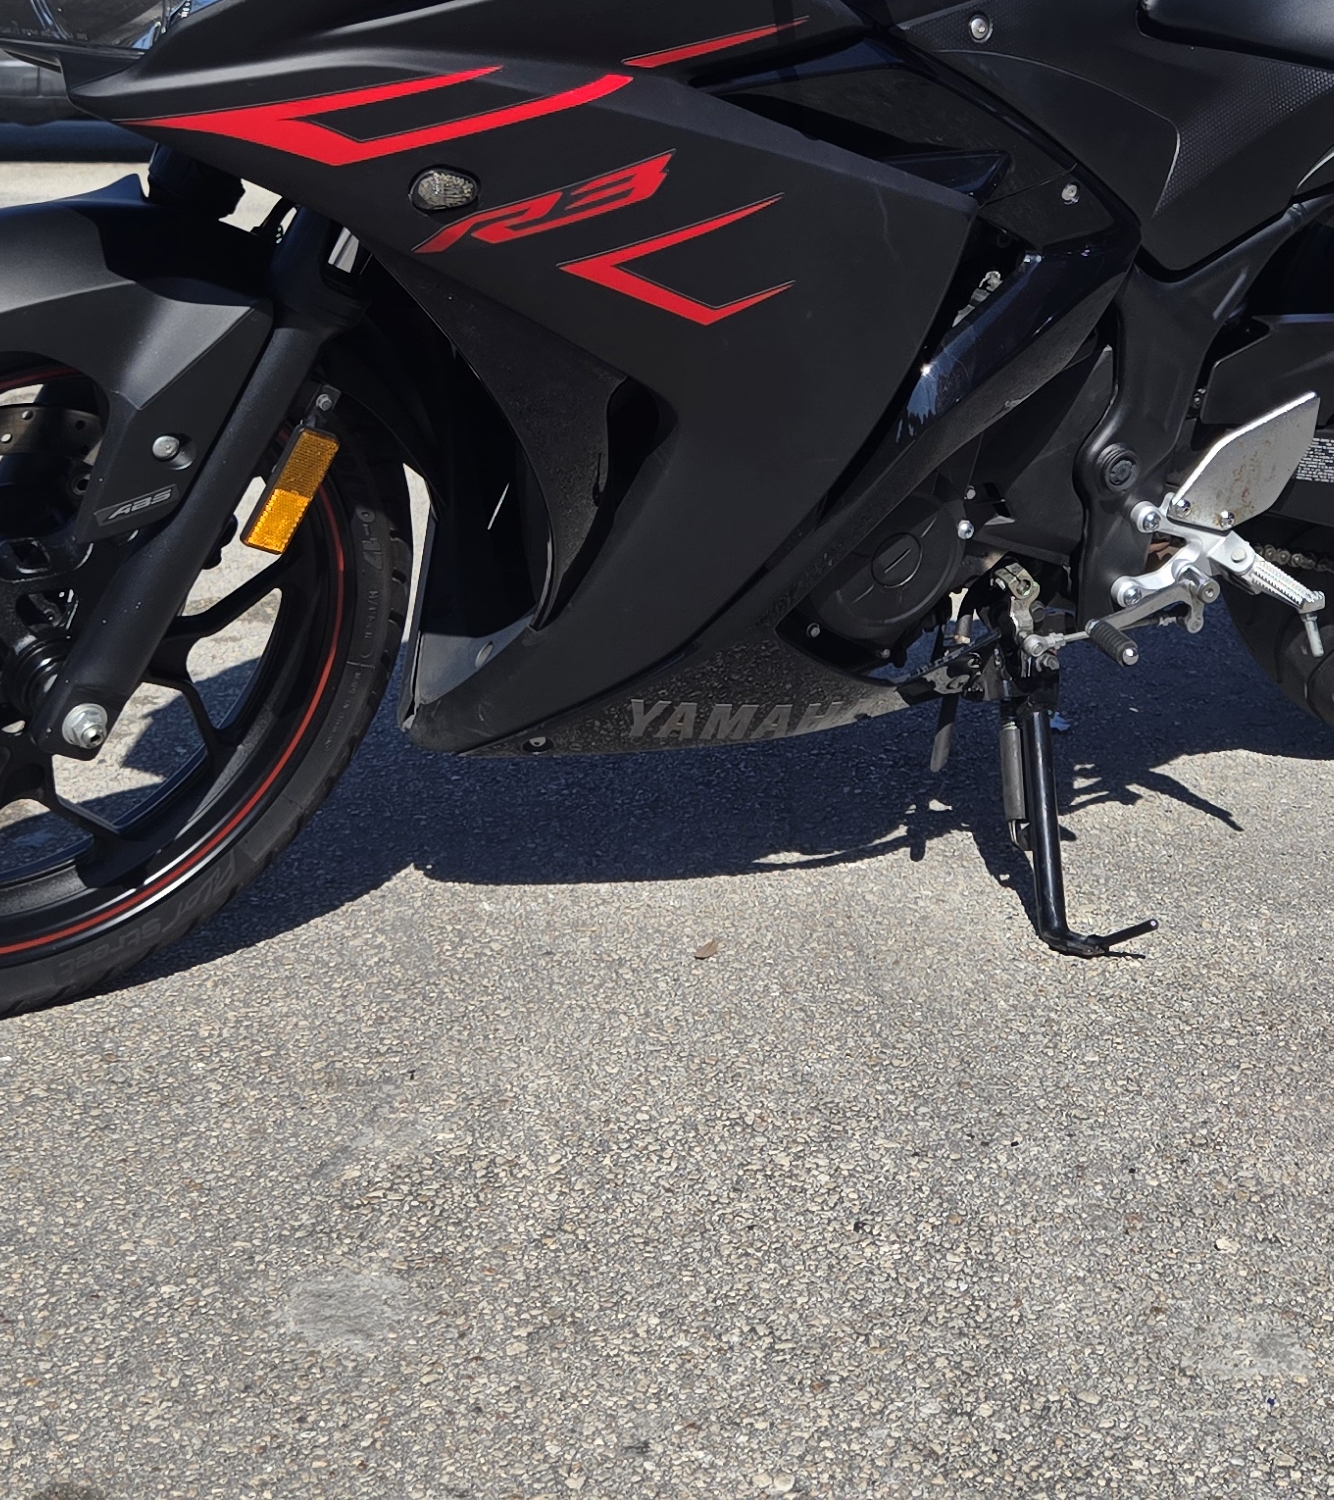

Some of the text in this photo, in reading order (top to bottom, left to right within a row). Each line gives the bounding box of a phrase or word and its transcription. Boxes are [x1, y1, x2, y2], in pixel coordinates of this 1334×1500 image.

[412, 150, 673, 254] R3
[108, 488, 172, 520] ABS
[629, 698, 849, 740] YAMAH
